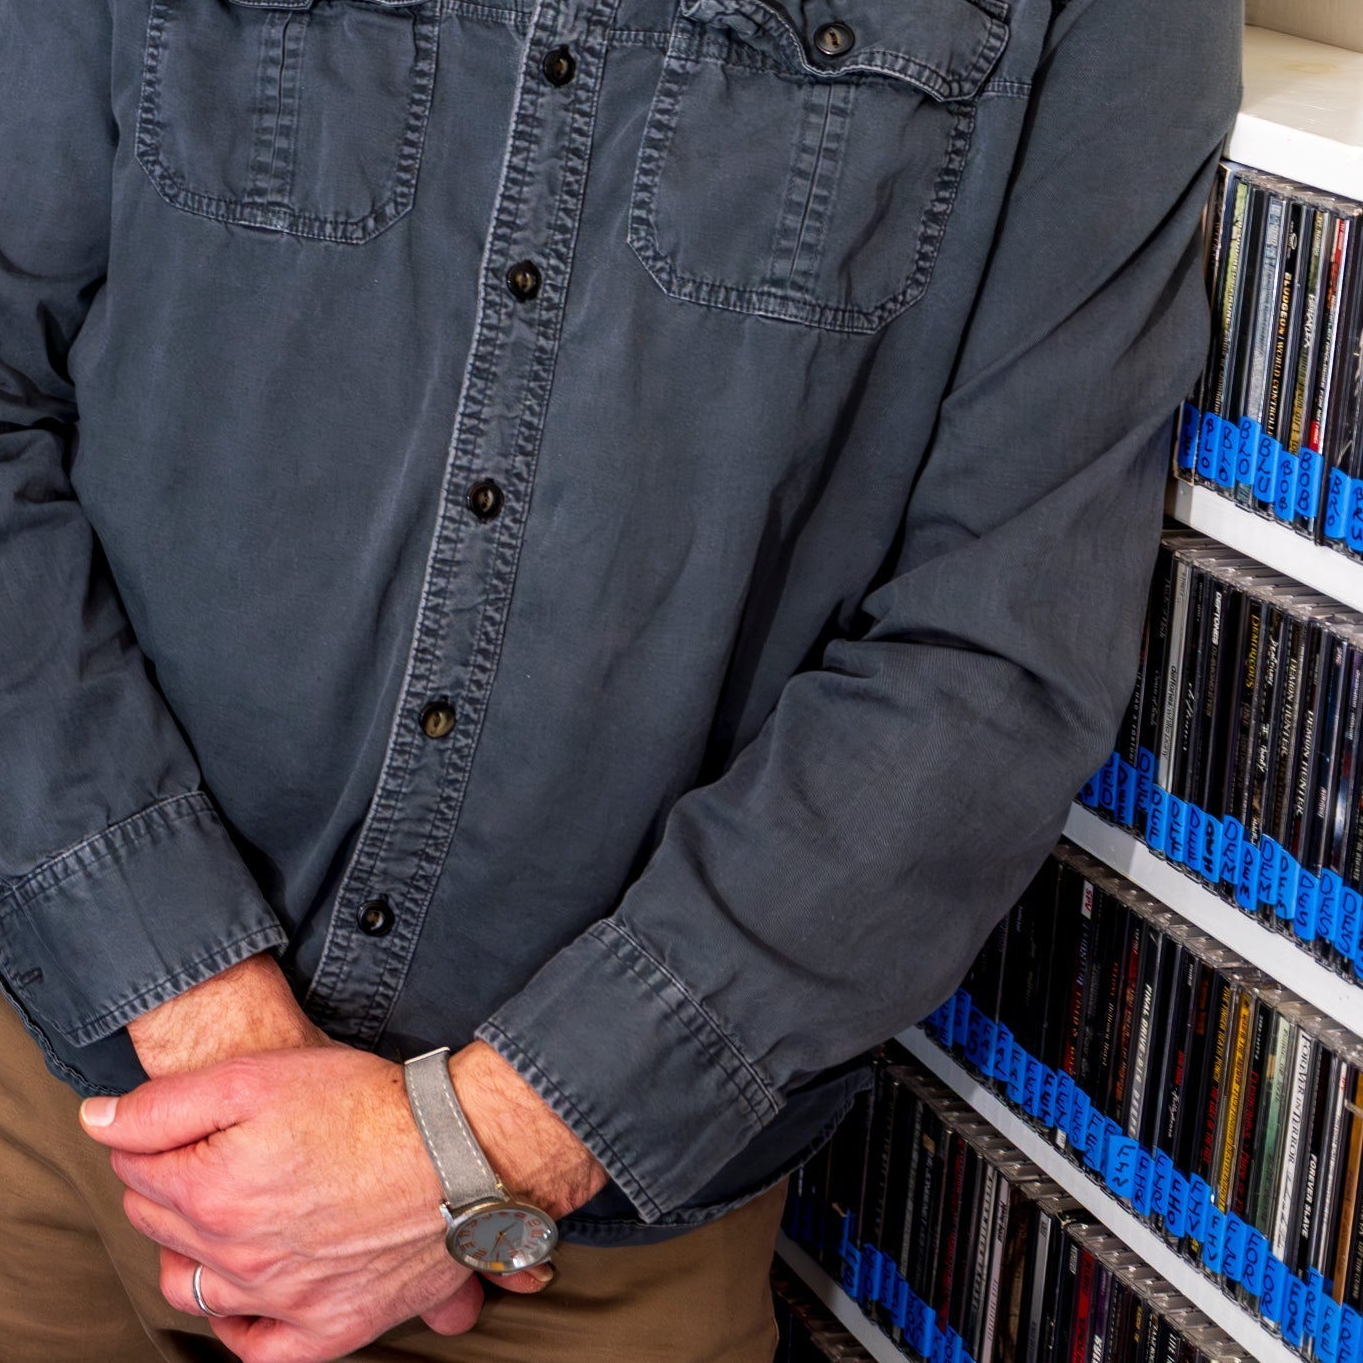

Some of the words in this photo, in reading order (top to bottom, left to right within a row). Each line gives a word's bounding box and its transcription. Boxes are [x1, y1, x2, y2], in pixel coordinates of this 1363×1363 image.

[1278, 272, 1292, 335] BLUDGEON
[1273, 341, 1283, 377] WORLD
[1281, 704, 1293, 758] HUNTER
[1295, 762, 1309, 816] HUNTER
[1340, 892, 1357, 953] DES
[1305, 1153, 1317, 1203] FOREVER
[1301, 1205, 1312, 1240] SLAVE
[1243, 1233, 1262, 1287] FOR
[1262, 1257, 1277, 1315] FOR
